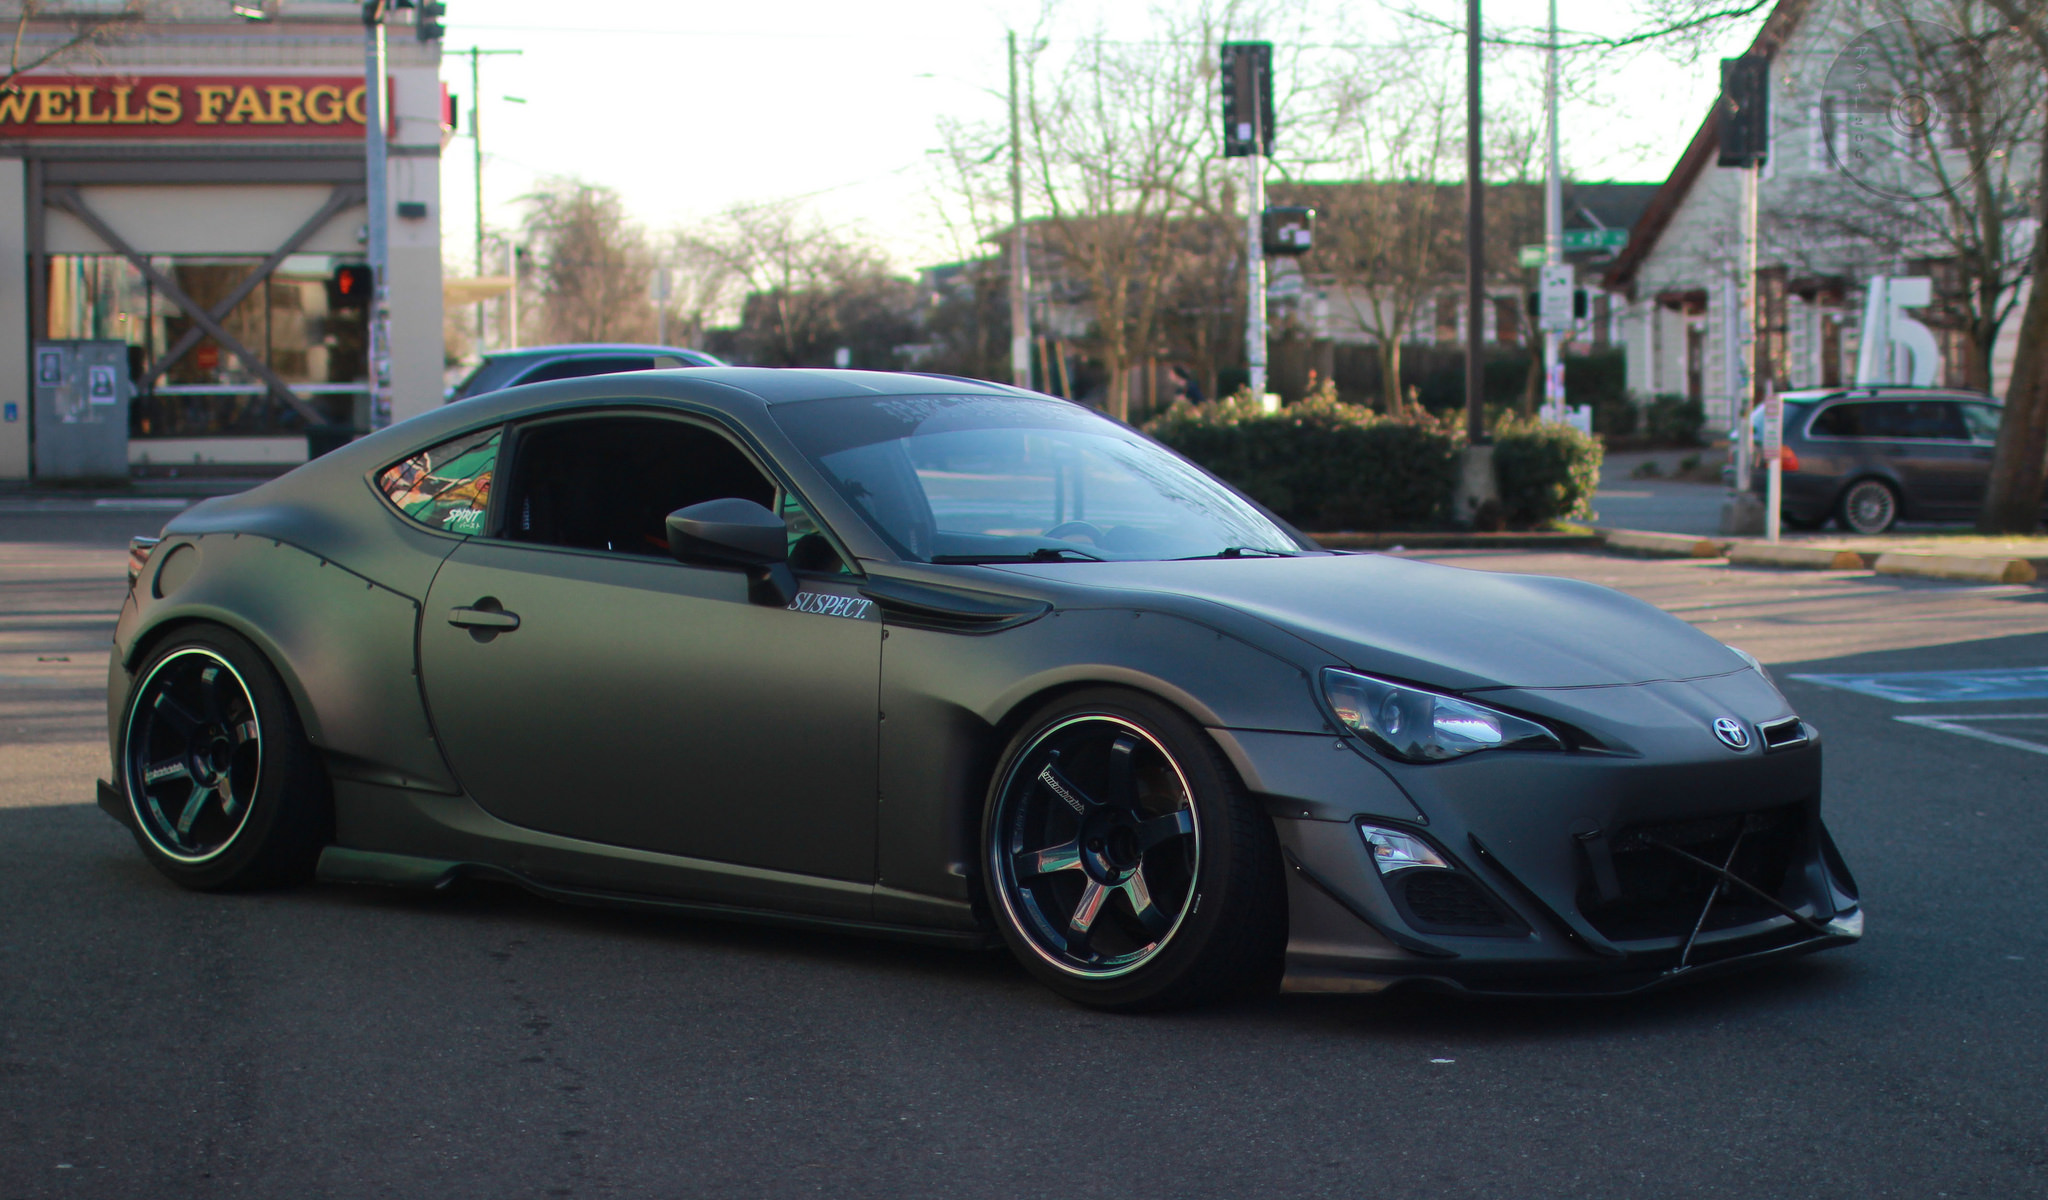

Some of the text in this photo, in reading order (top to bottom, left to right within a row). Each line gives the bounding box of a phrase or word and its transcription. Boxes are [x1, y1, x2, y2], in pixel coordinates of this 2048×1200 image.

[0, 84, 182, 123] WELLS
[443, 509, 482, 523] SPIRIT
[787, 592, 872, 619] SUSPECT.
